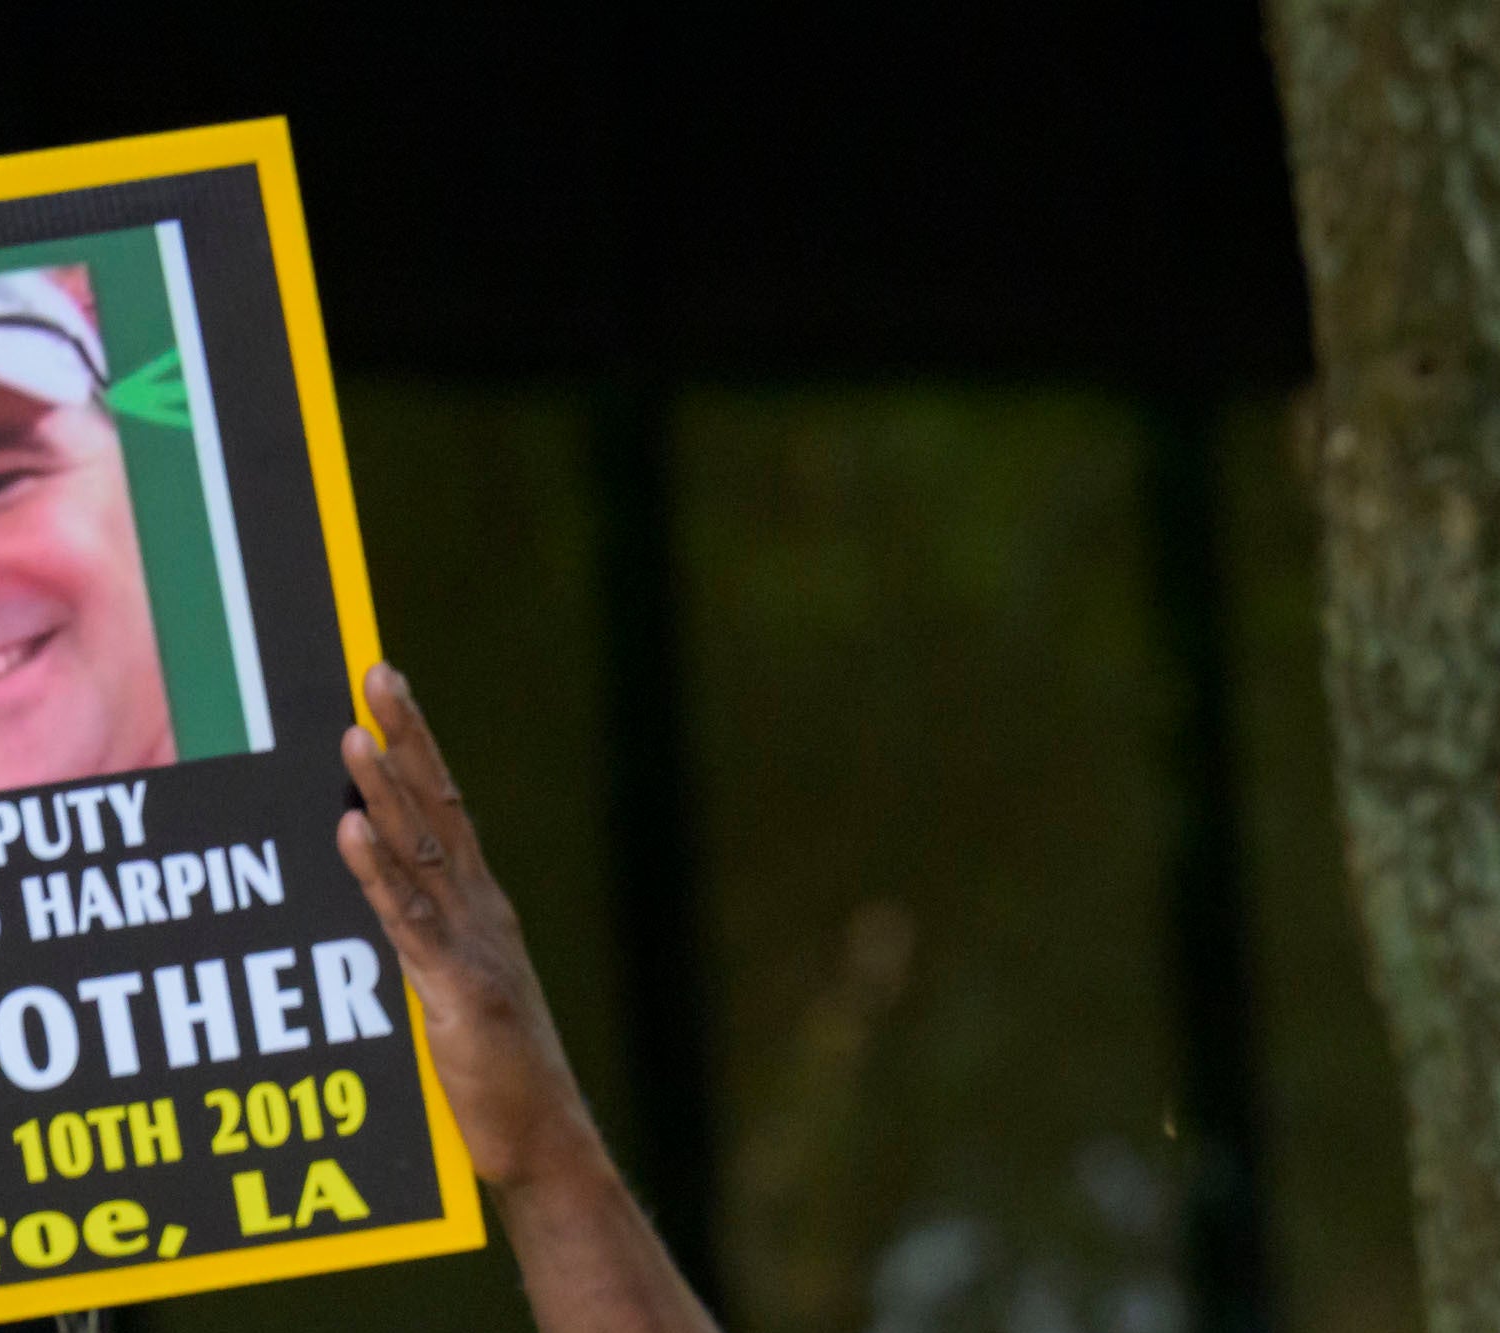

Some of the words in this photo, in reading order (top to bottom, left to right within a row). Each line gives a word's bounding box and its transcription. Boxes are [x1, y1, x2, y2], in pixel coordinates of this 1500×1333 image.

[21, 839, 285, 942] HARPIN
[12, 1098, 183, 1184] 10TH
[204, 1069, 368, 1156] 2019
[232, 1158, 371, 1237] LA
